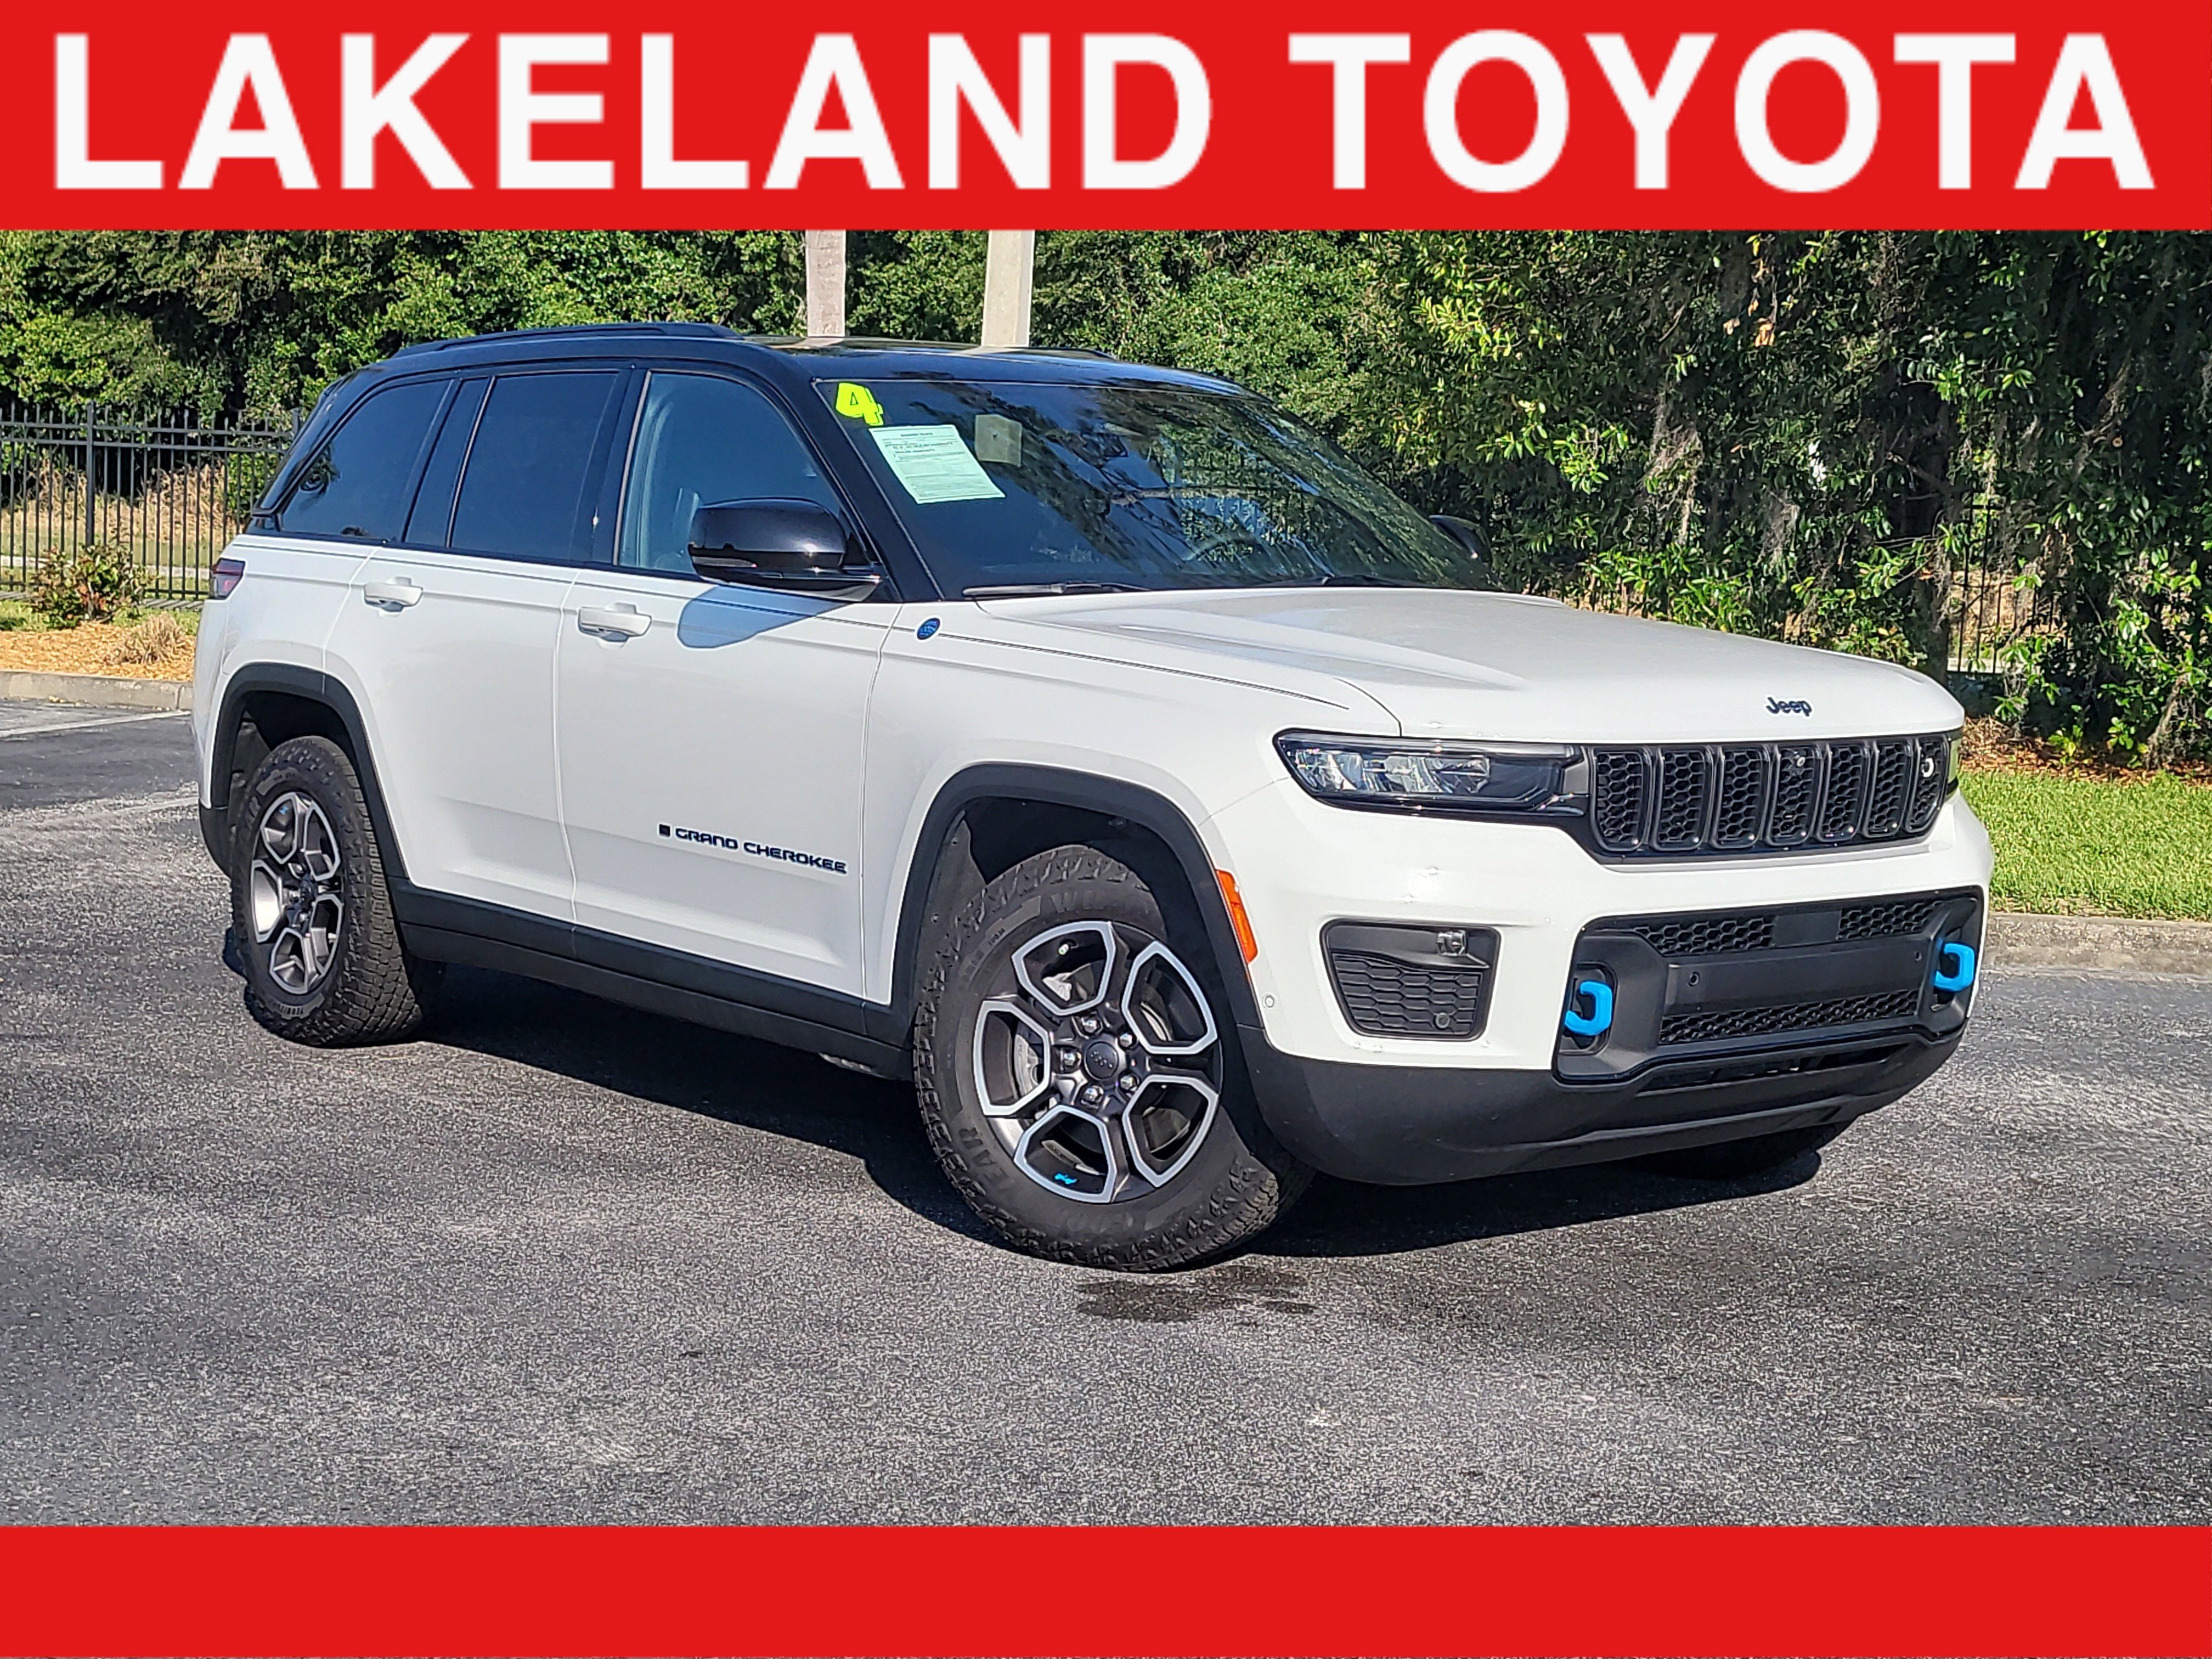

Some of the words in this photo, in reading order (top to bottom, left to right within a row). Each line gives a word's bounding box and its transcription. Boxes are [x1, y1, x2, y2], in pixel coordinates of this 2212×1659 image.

[835, 382, 884, 426] 4
[1765, 696, 1813, 717] Jeep
[675, 827, 738, 850] GRAND
[743, 842, 847, 874] CHEROKEE
